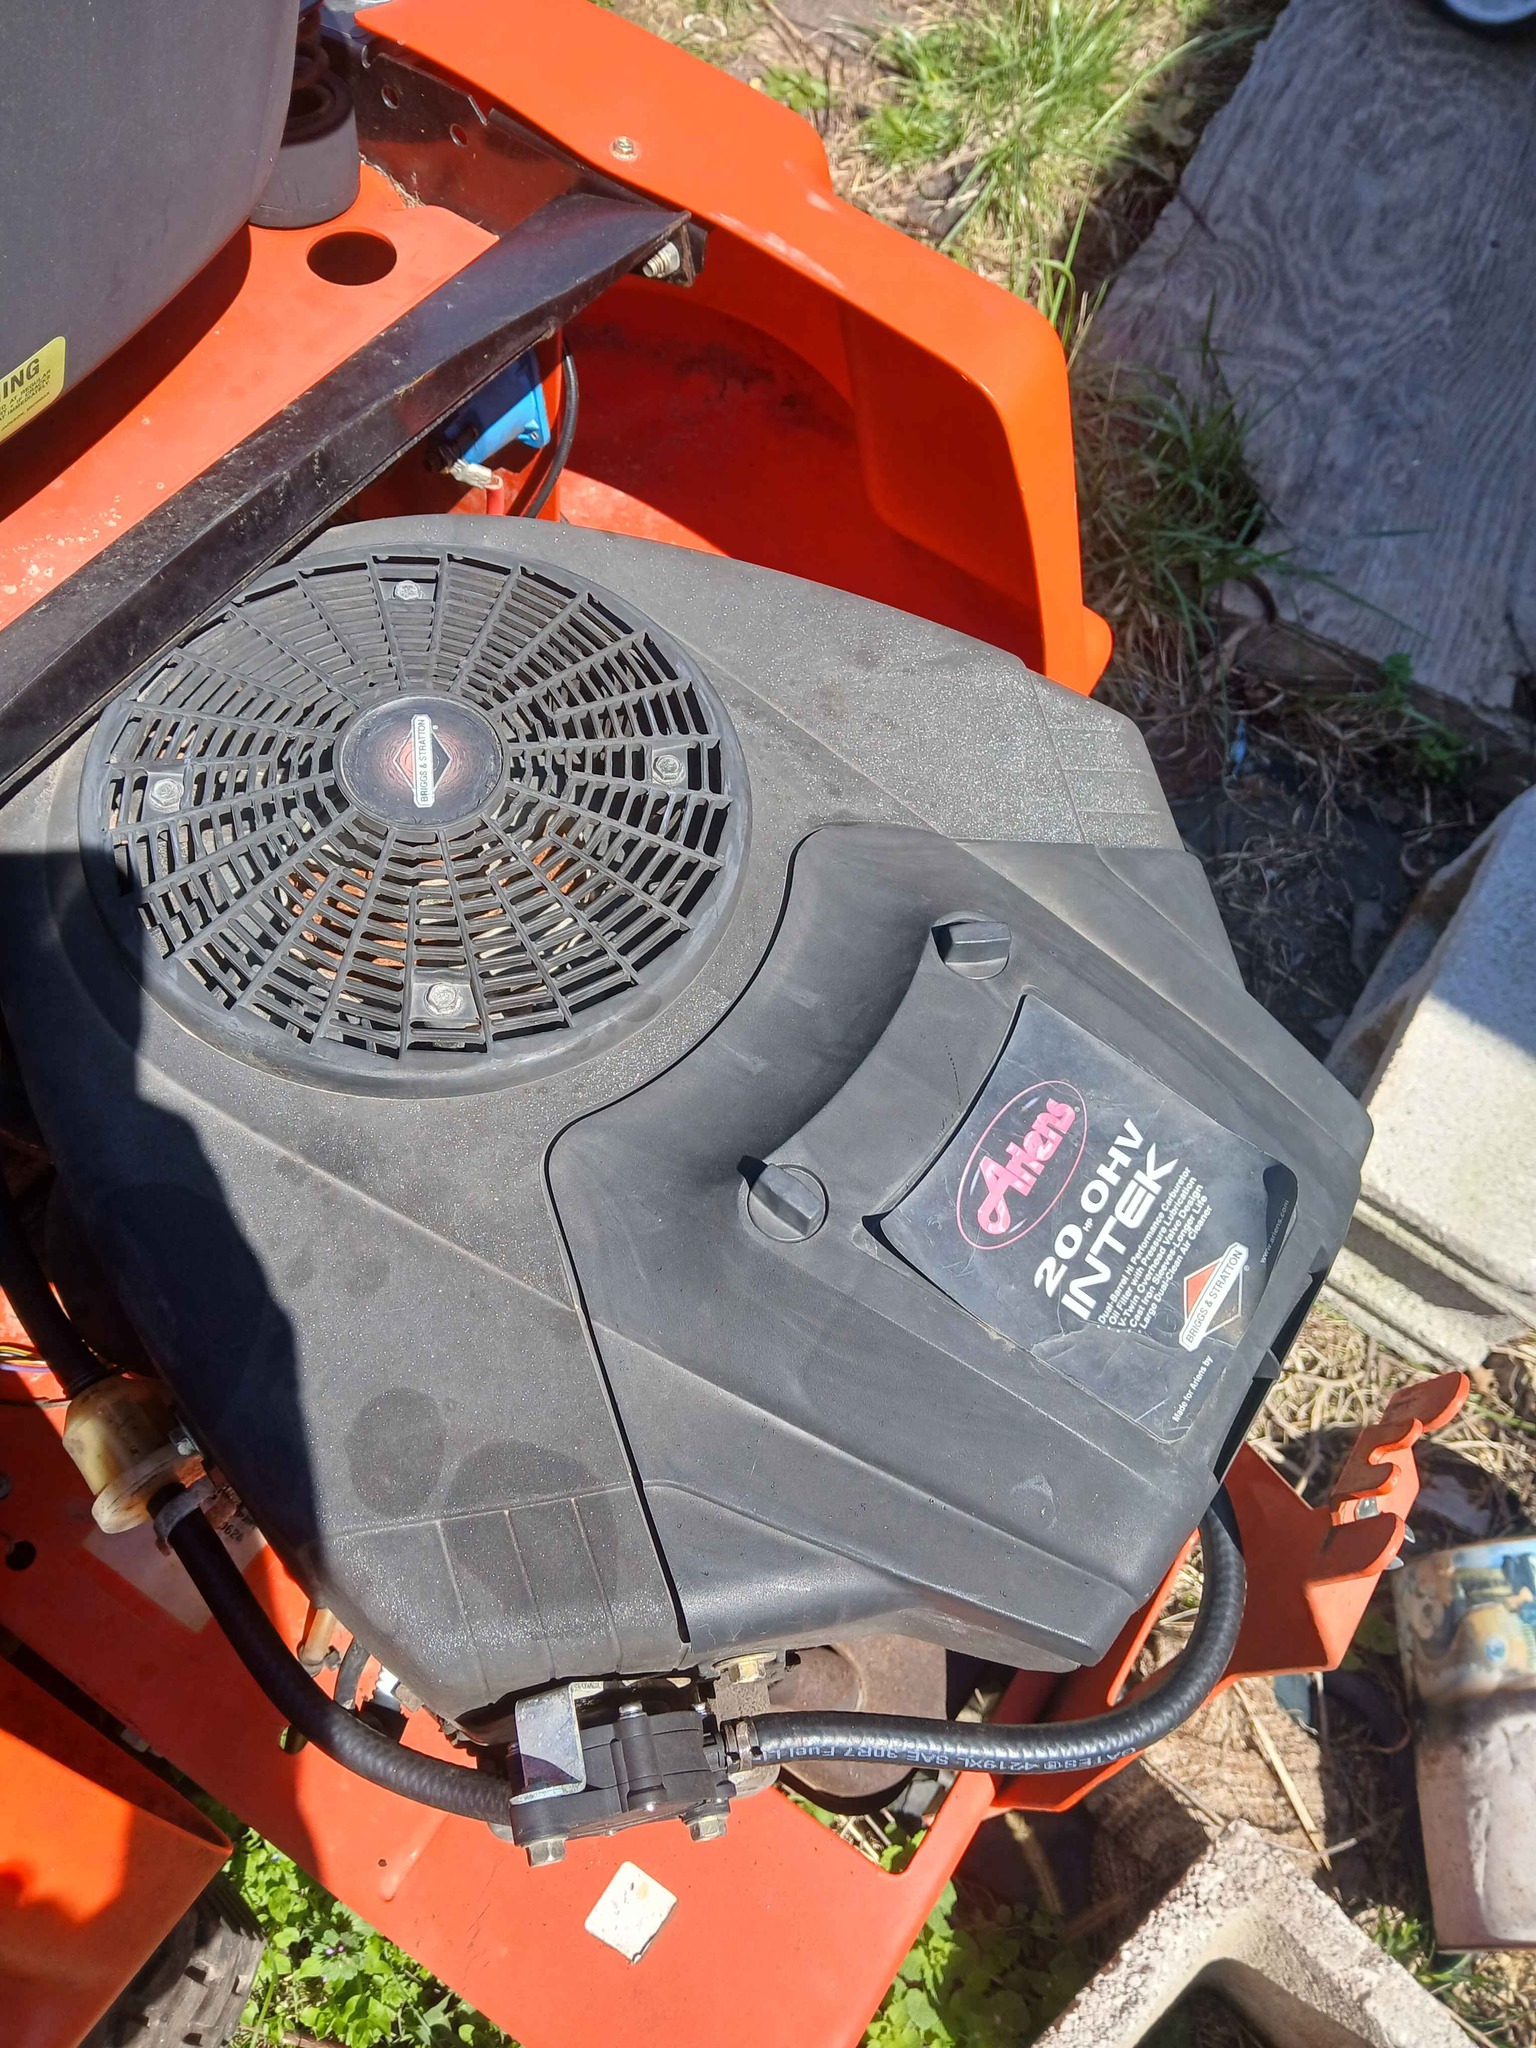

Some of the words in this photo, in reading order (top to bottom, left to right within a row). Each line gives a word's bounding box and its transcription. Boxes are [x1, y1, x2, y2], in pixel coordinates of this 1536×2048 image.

[20, 369, 51, 395] REGULAR
[418, 719, 427, 761] STRATTON
[419, 761, 428, 769] &
[419, 769, 429, 802] BRIGGS
[977, 1098, 1076, 1235] Ariens
[1034, 1224, 1084, 1298] 20
[1081, 1118, 1144, 1214] OHV
[1061, 1142, 1179, 1320] INTEK
[1098, 1275, 1127, 1324] Dual-Barrel
[1130, 1211, 1164, 1264] Performance
[1161, 1166, 1190, 1211] Carburetor
[1107, 1309, 1121, 1326] Oil
[1116, 1287, 1133, 1310] Filter
[1129, 1266, 1144, 1286] with
[1141, 1226, 1167, 1266] Pressure
[1163, 1176, 1195, 1226] Lubrication
[1118, 1294, 1139, 1327] V-Twin
[1136, 1245, 1166, 1293] Overhead
[1163, 1219, 1182, 1246] Valve
[1179, 1184, 1203, 1219] Design
[1129, 1306, 1145, 1328] Cast
[1141, 1285, 1155, 1305] Iron
[1152, 1214, 1196, 1284] Sleeves-Longer
[1192, 1194, 1207, 1214] Life
[1139, 1302, 1158, 1329] Large
[1154, 1255, 1182, 1301] Dual-Clean
[1179, 1240, 1191, 1255] Air
[1188, 1205, 1212, 1240] Cleaner
[1260, 1200, 1288, 1263] www.ariens.com
[1186, 1308, 1207, 1342] BRIGGS
[1203, 1299, 1212, 1308] &
[1209, 1250, 1241, 1299] STRATTON
[1172, 1401, 1187, 1421] Made
[1184, 1389, 1193, 1401] for
[1190, 1366, 1206, 1389] Ariens
[1202, 1354, 1214, 1368] by
[906, 1750, 949, 1766] SAE
